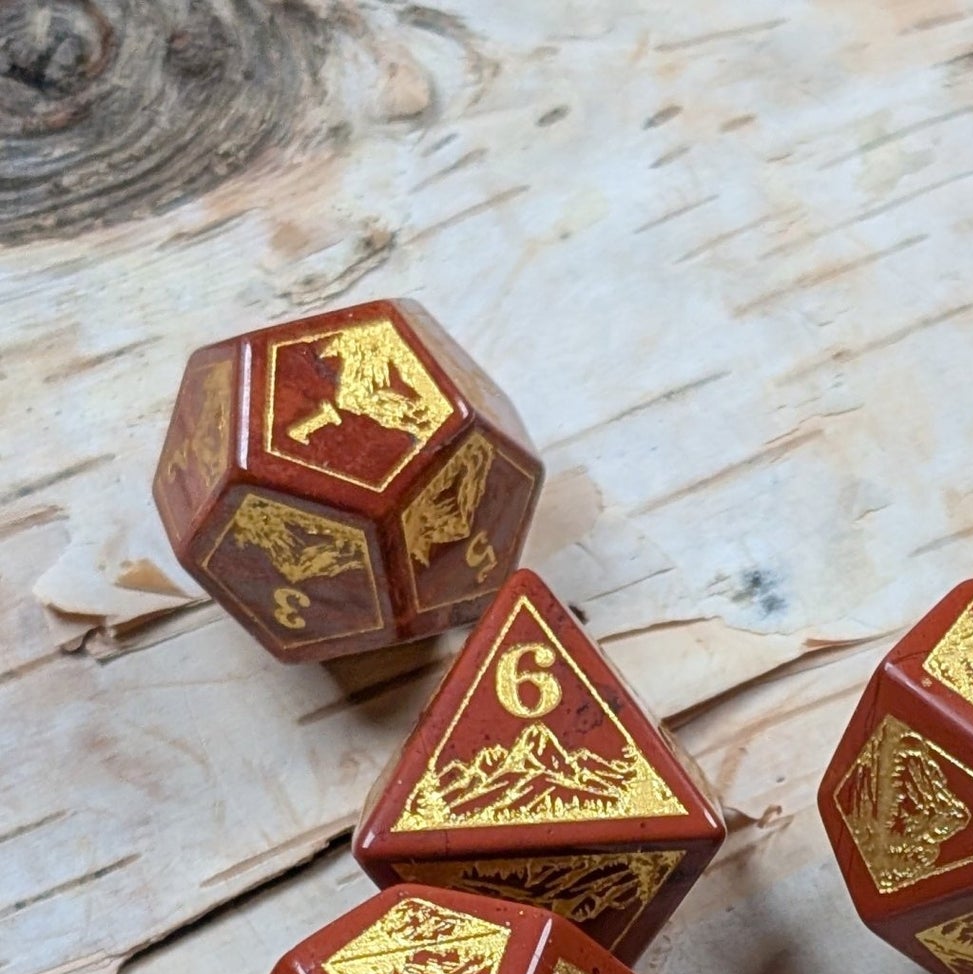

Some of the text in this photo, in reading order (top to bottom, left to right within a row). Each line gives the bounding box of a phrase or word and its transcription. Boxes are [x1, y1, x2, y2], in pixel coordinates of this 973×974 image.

[286, 400, 342, 445] 1
[465, 531, 498, 584] 5
[272, 587, 311, 630] 3
[495, 642, 563, 718] 6
